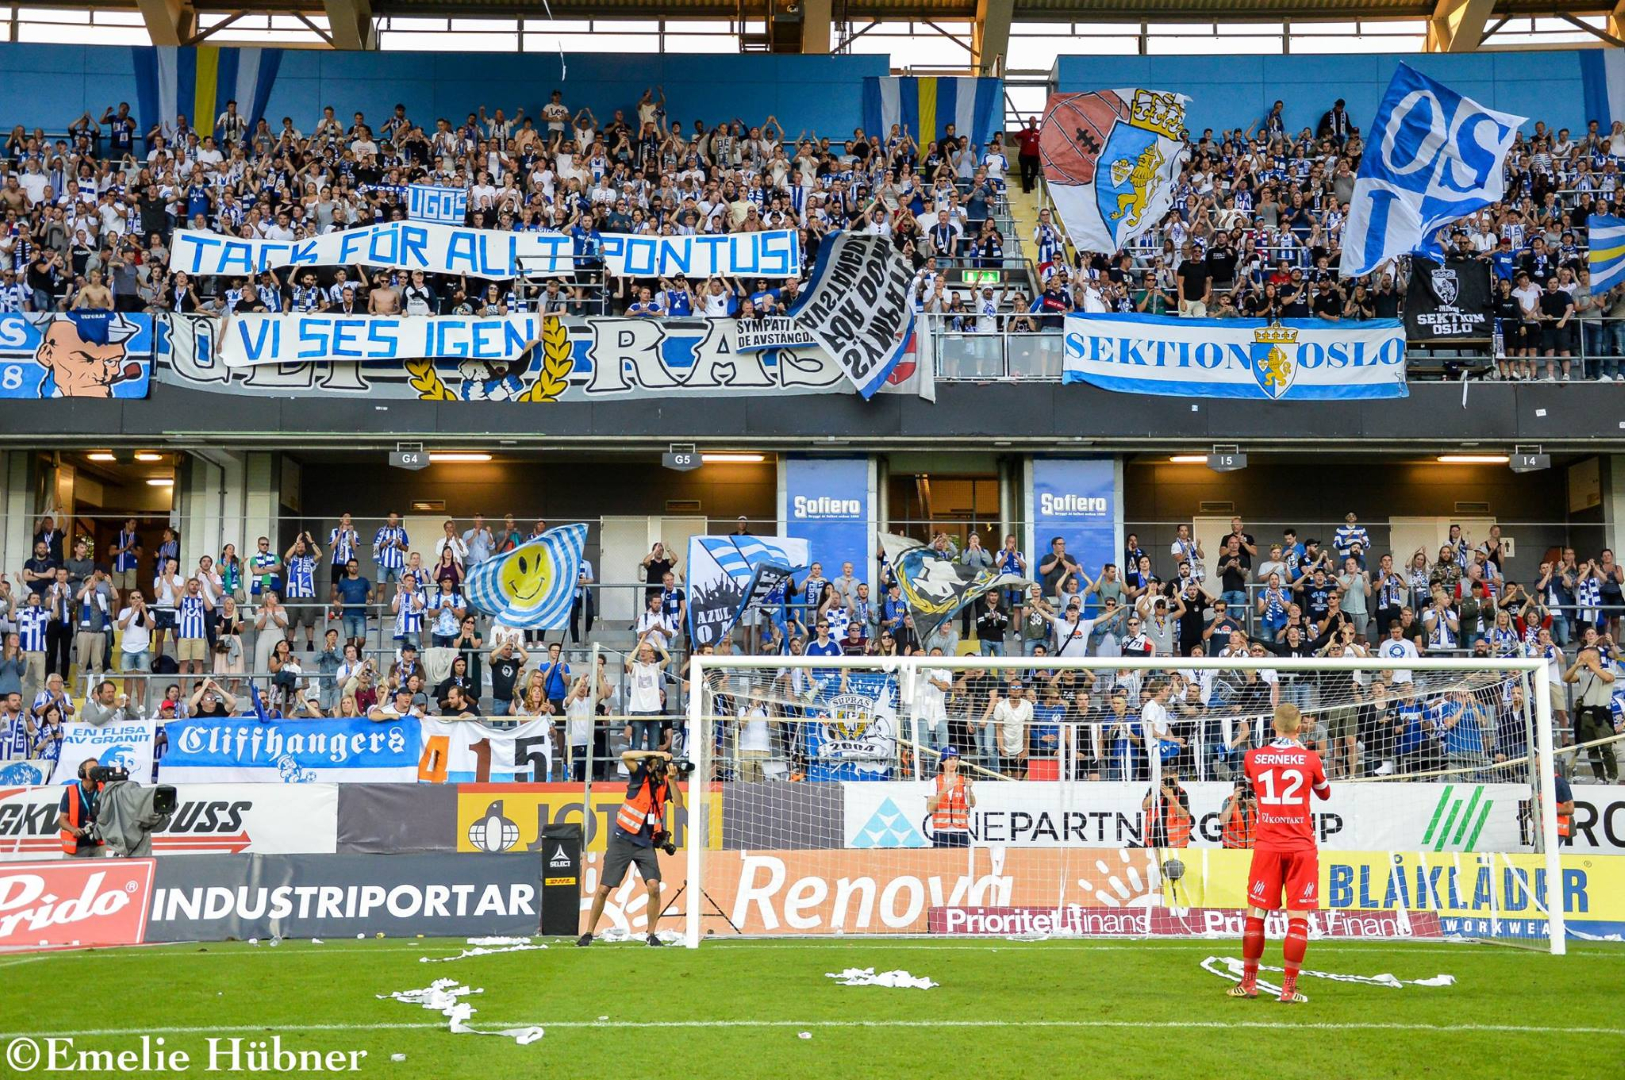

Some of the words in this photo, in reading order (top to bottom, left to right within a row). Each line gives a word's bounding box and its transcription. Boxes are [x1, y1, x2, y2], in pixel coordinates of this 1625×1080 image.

[181, 234, 318, 273] TACK
[339, 222, 429, 267] FÖR
[601, 230, 797, 275] PONTUS!
[736, 319, 790, 334] SYMPATI
[1417, 312, 1486, 325] SEKTION
[1433, 323, 1473, 335] OSLO
[238, 319, 280, 360] VI
[298, 318, 399, 358] SES
[425, 319, 533, 358] IGEN
[738, 335, 752, 348] DE
[1065, 332, 1250, 370] SEKTION
[1298, 337, 1405, 369] OSLO
[402, 454, 418, 463] G4
[675, 455, 691, 464] G5
[794, 495, 861, 518] Sofiero
[1041, 493, 1107, 516] Sofiero
[697, 607, 732, 624] AZUL
[832, 696, 871, 706] SUPRAS
[63, 736, 87, 744] AV
[91, 734, 150, 744] GRANIT
[72, 728, 98, 736] EN
[102, 726, 146, 735] FLISA
[178, 726, 405, 762] Cliffhangers
[1254, 754, 1306, 765] SERNEKE
[1258, 769, 1304, 805] 12
[1329, 853, 1589, 913] BLÅKLÄDER
[152, 884, 536, 921] INDUSTRIPORTAR
[946, 909, 1059, 933] Prioritet
[1328, 910, 1412, 937] Finans
[1446, 920, 1561, 935] WORKWEA
